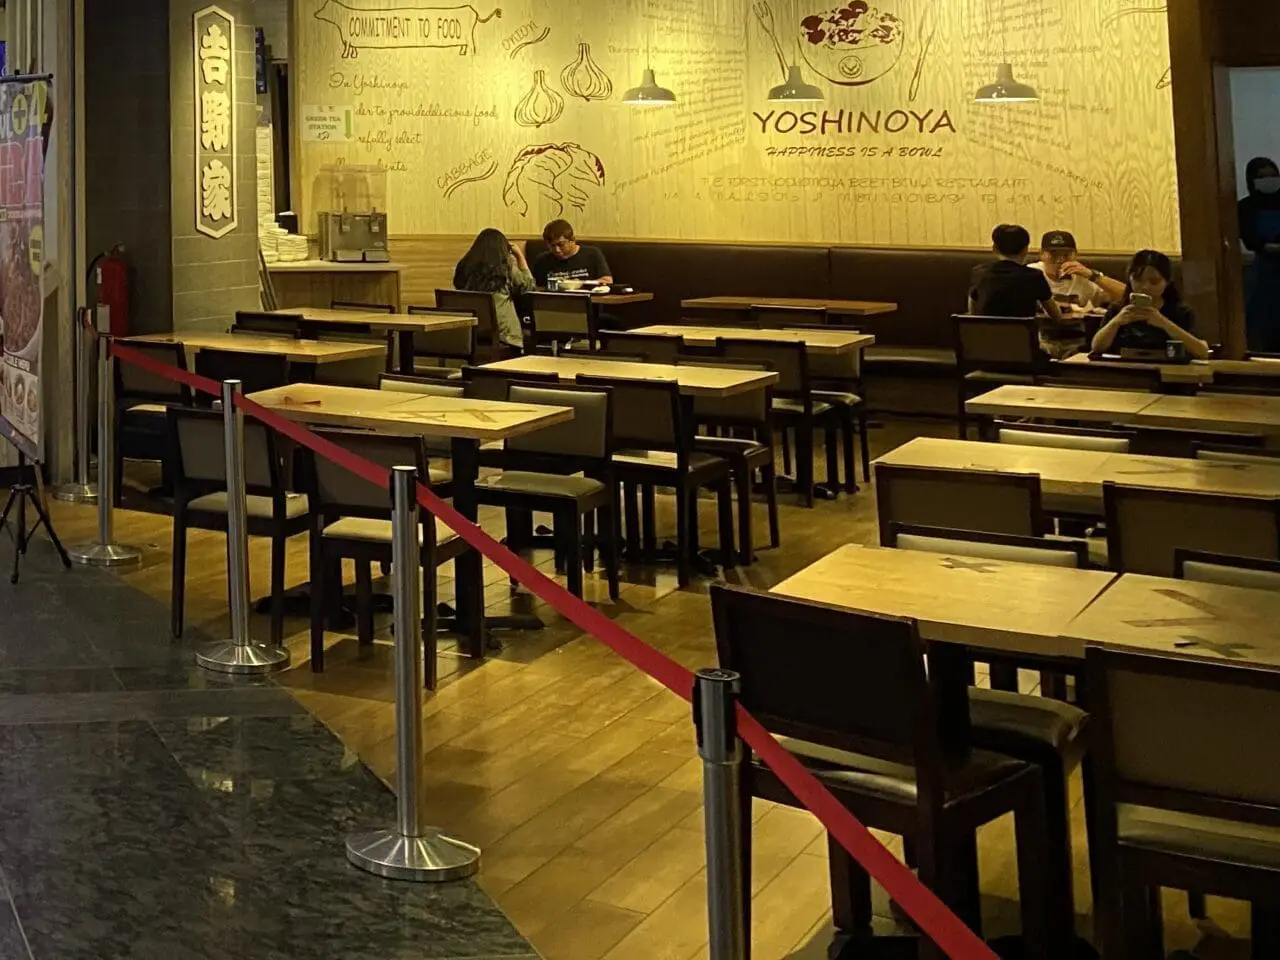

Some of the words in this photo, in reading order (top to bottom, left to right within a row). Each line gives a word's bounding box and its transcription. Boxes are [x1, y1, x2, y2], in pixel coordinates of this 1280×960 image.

[349, 16, 411, 38] COMMITMENT
[418, 17, 430, 38] TO
[437, 17, 462, 39] FOOD
[502, 20, 539, 50] ONION
[328, 72, 353, 88] In
[753, 108, 956, 135] YOSHINOYA
[765, 146, 856, 158] HAPPINESS
[861, 146, 878, 157] IS
[880, 146, 895, 157] A
[898, 146, 943, 158] BOWL
[437, 148, 493, 189] CABBAGE
